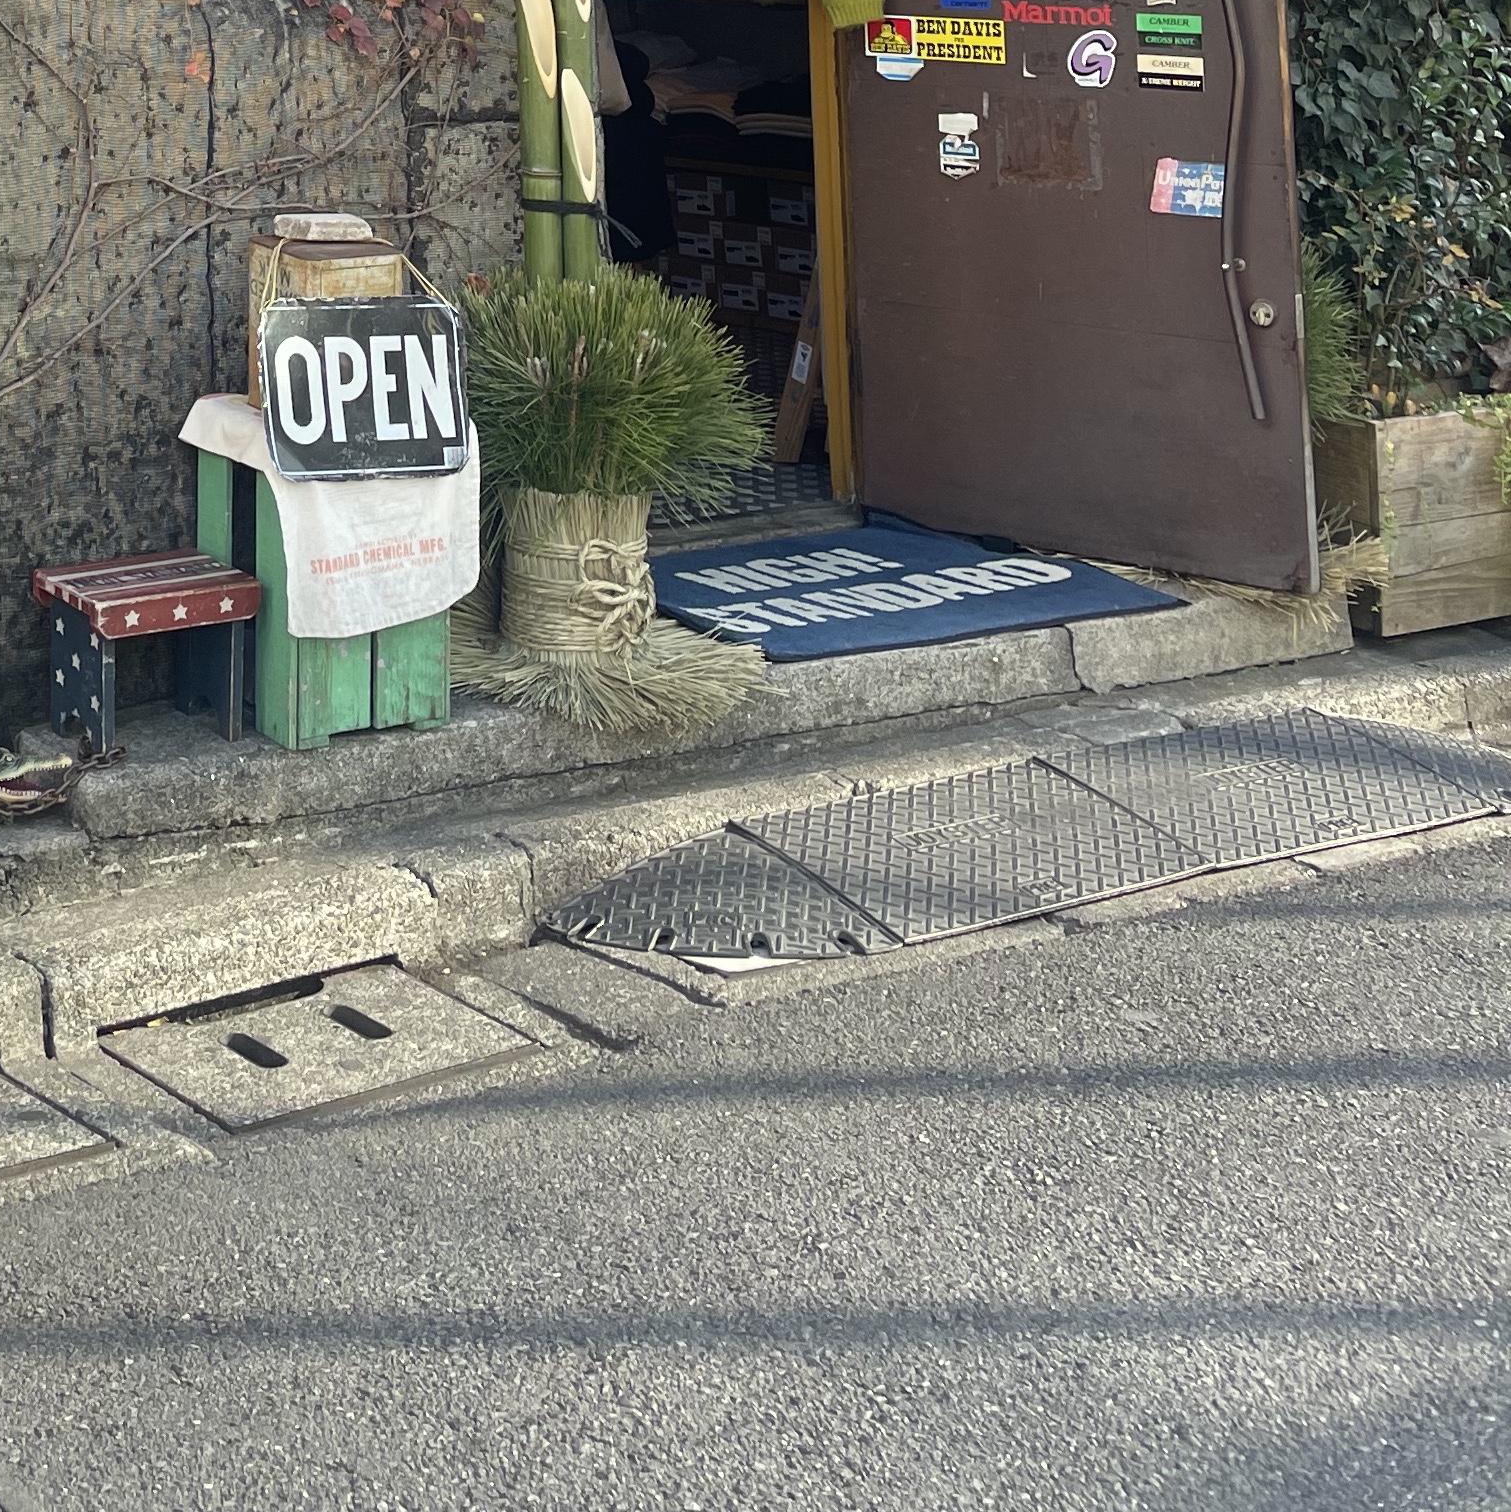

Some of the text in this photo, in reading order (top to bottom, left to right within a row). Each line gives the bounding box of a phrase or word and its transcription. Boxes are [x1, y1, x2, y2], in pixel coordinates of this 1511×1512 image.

[1002, 0, 1113, 27] Marmot
[1149, 17, 1190, 27] CAMBER
[916, 19, 1002, 38] BEN DAVIS
[917, 42, 1004, 62] PRESIDENT
[1151, 59, 1191, 69] CAMBER
[274, 334, 457, 445] OPEN
[310, 552, 360, 575] STANDARD
[363, 541, 415, 564] CHEMICAL
[419, 537, 447, 555] MFG.
[674, 547, 904, 594] HIGH!
[681, 557, 1073, 634] STANDARD
